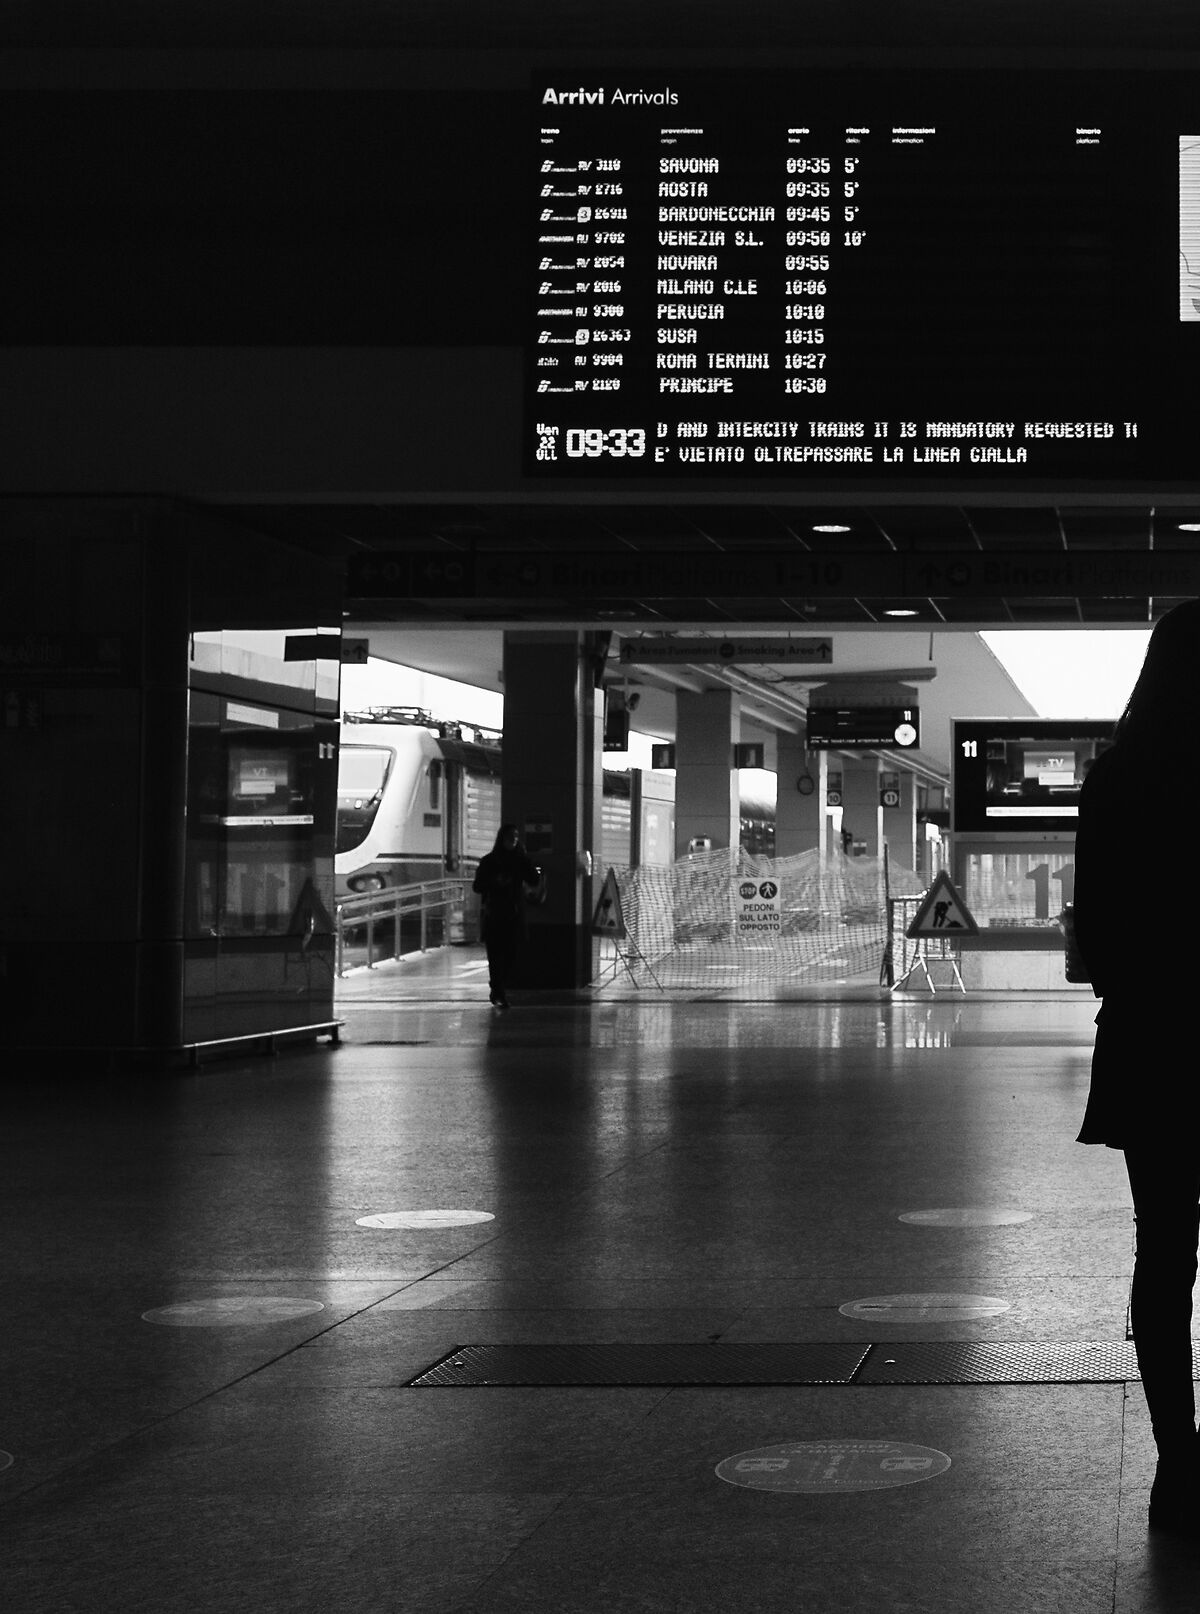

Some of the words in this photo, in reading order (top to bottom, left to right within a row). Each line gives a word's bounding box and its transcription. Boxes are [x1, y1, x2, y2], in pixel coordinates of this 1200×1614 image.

[542, 87, 605, 105] Arrivi
[610, 87, 679, 105] Arrivals
[660, 127, 704, 136] provenienza
[787, 127, 810, 135] orario
[845, 127, 870, 135] ritardo
[891, 127, 936, 135] informazioni
[1075, 127, 1102, 135] binario
[891, 137, 925, 145] information
[659, 157, 720, 174] SAVONA
[786, 157, 831, 174] 09:35
[658, 181, 709, 198] AOSTA
[786, 181, 831, 198] 09:35
[658, 206, 776, 222] BARDONECCHIA
[786, 206, 831, 222] 09:45
[658, 230, 726, 247] VENEZIA
[734, 230, 764, 247] S.L.
[785, 230, 831, 247] 09:50
[657, 254, 718, 271] NOVARA
[785, 254, 830, 271] 09:55
[656, 279, 714, 295] MILANO
[723, 279, 758, 295] C.LE
[784, 279, 827, 296] 10:06
[656, 303, 725, 320] PERUGIA
[785, 303, 825, 320] 10:10
[656, 327, 698, 344] SUSA
[784, 328, 825, 345] 10:15
[656, 353, 697, 369] ROMA
[706, 352, 770, 370] TERMINI
[784, 352, 827, 370] 10:27
[659, 377, 734, 394] PRINCIPE
[784, 377, 827, 394] 10:30
[676, 421, 708, 438] AND
[716, 421, 799, 438] INTERCITY
[808, 421, 865, 438] TRAINS
[873, 421, 889, 438] IT
[899, 421, 917, 438] IS
[925, 421, 1016, 438] MANDATORY
[1024, 422, 1115, 438] REQUESTED
[566, 428, 646, 457] 09:33
[678, 446, 745, 463] VIETATO
[754, 446, 874, 463] OLTREPASSARE
[883, 446, 904, 463] LA
[913, 446, 961, 463] LINEA
[969, 446, 1028, 463] GIALLA
[551, 560, 643, 585] Binari
[983, 560, 1073, 585] Binari
[1079, 560, 1192, 586] Platforms
[737, 645, 785, 658] Smoking
[961, 740, 978, 758] 11
[1048, 758, 1064, 768] TV
[1025, 863, 1075, 919] 11
[743, 903, 775, 912] PEDONI
[739, 913, 756, 922] SUL
[757, 913, 780, 921] LATO
[740, 923, 780, 931] OPPOSTO
